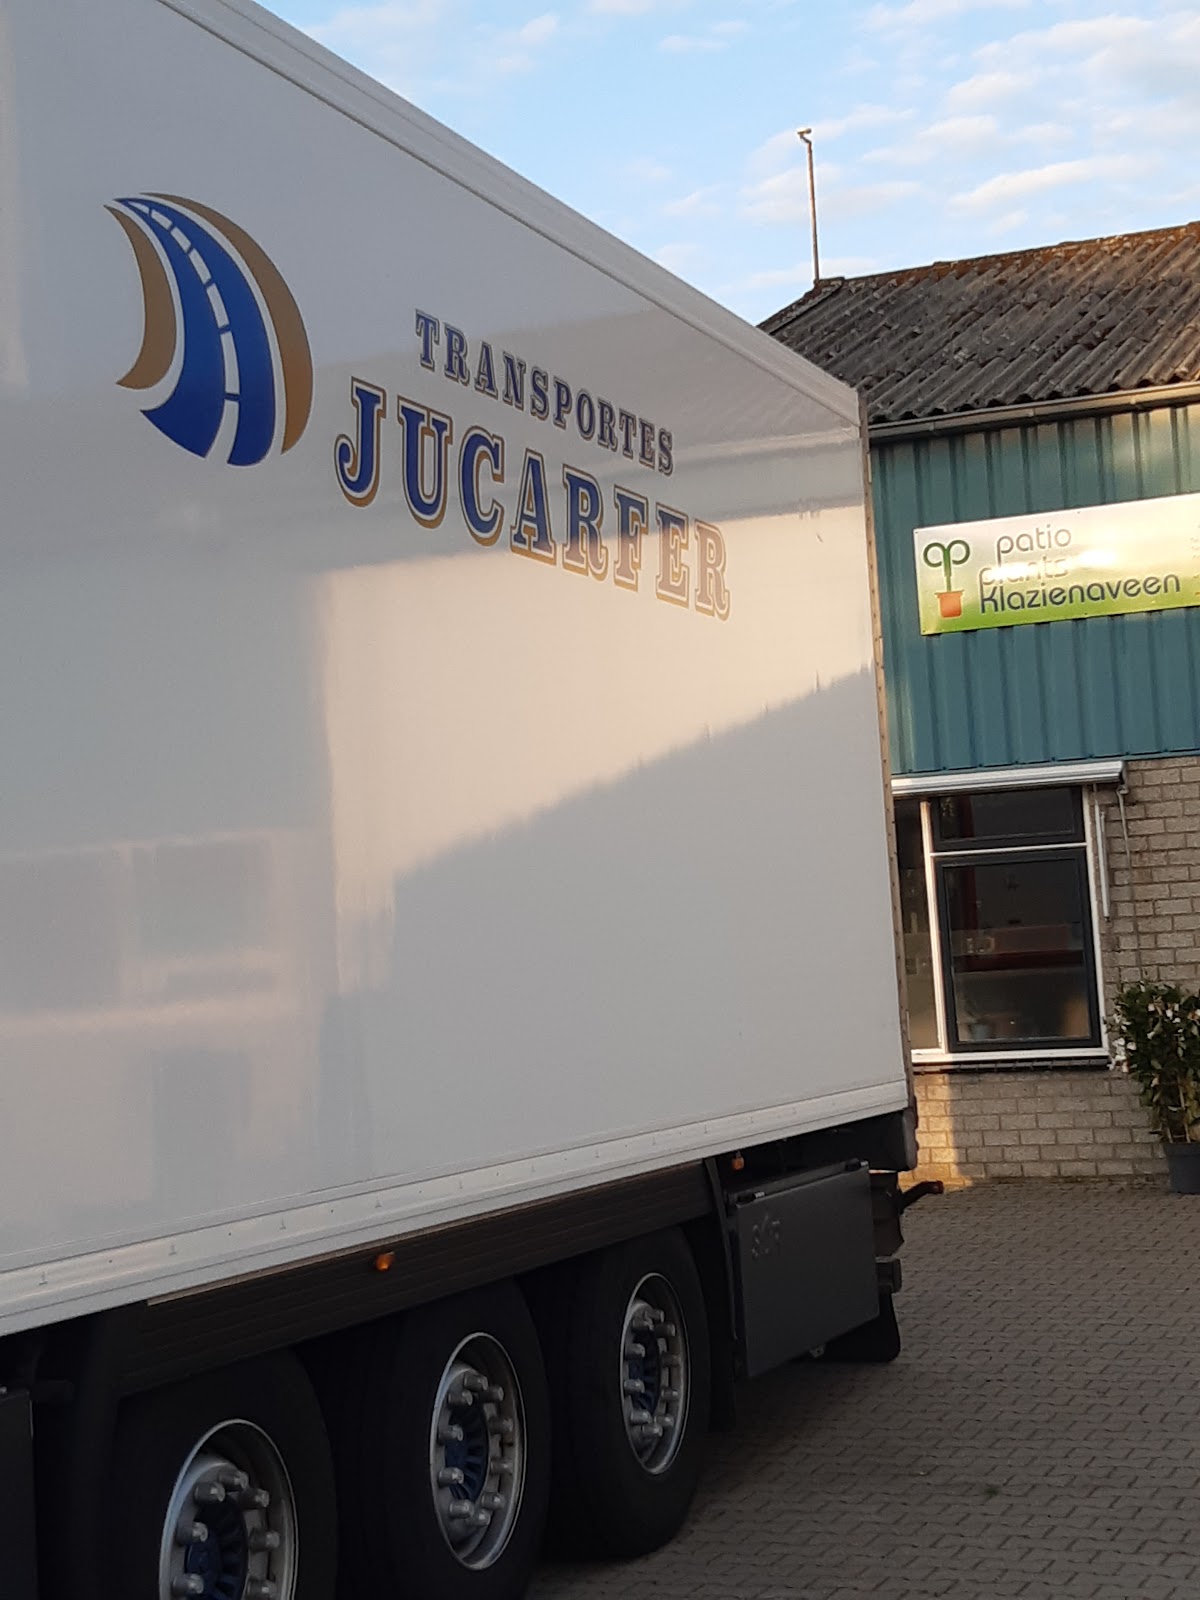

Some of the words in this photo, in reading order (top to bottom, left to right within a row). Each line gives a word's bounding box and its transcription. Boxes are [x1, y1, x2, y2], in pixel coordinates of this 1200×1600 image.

[415, 308, 674, 476] TRANSPORTES
[333, 376, 731, 621] JUCARFER
[996, 523, 1072, 567] patio
[979, 555, 1069, 592] pnts
